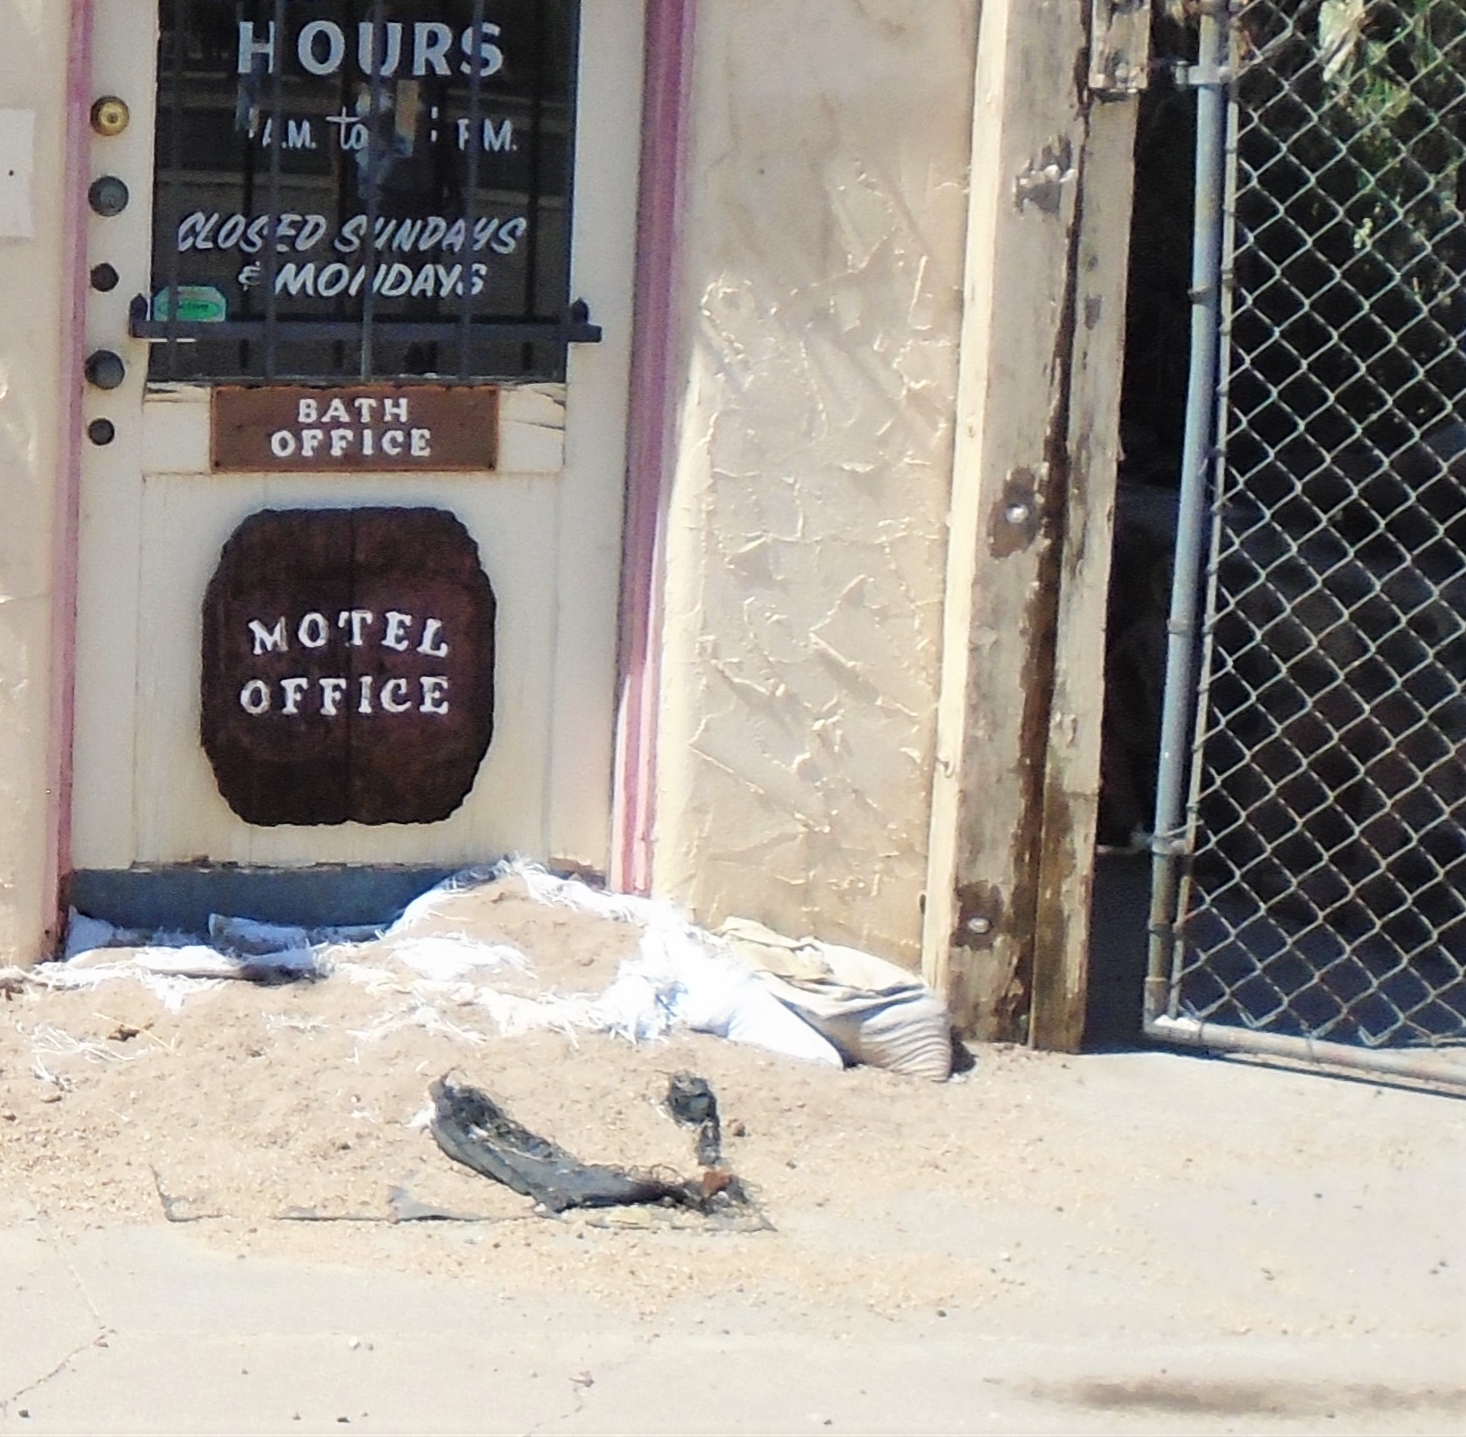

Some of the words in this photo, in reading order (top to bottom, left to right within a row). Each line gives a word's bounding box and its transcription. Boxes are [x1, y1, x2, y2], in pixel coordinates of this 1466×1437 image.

[237, 19, 505, 77] HOURS
[326, 106, 369, 150] to
[178, 211, 328, 253] CLOSED
[334, 214, 528, 254] SUNDAYS
[275, 262, 488, 298] MONDAYS
[297, 397, 409, 424] BATH
[270, 428, 432, 457] OFFICE
[247, 609, 449, 659] MOTEL
[239, 675, 450, 716] OFFICE
